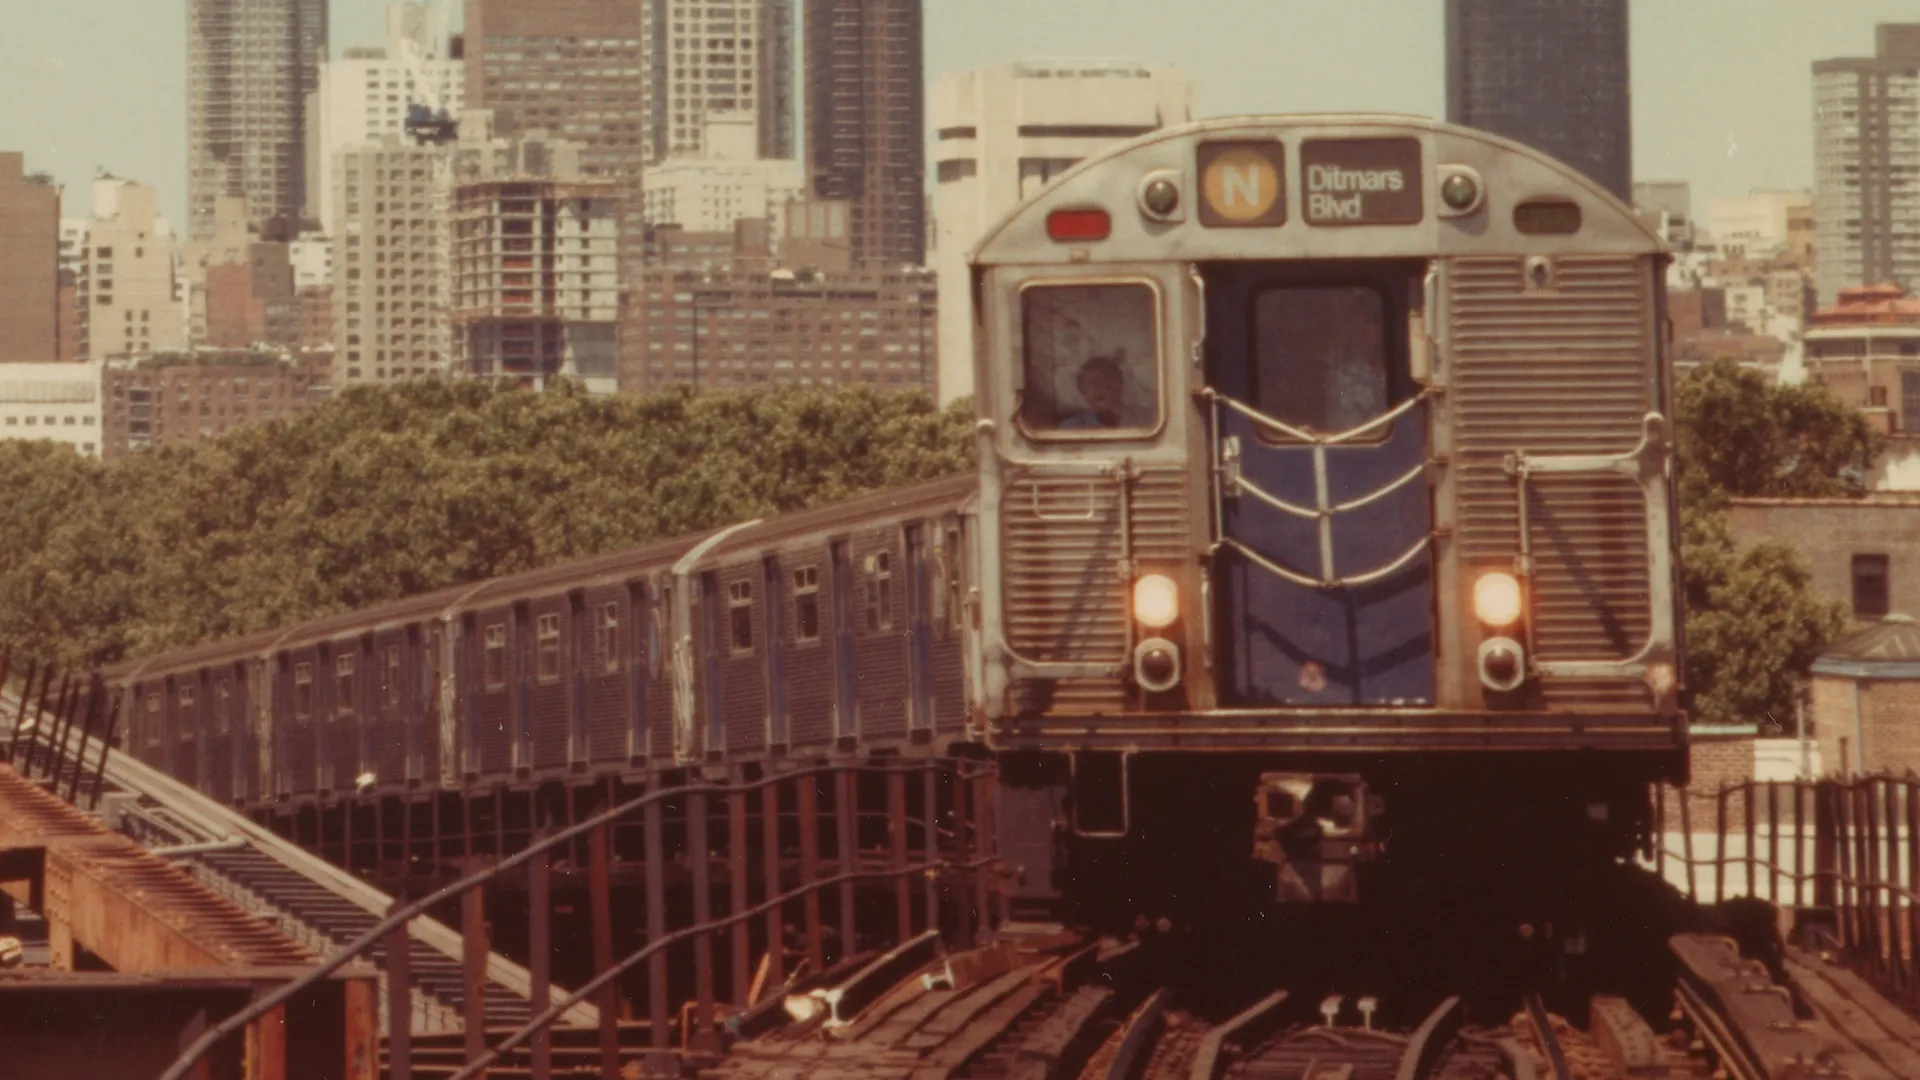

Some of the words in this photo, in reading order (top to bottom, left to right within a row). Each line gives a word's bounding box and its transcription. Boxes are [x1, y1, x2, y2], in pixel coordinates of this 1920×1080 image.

[1222, 164, 1260, 207] N
[1307, 165, 1404, 191] Ditmars
[1308, 193, 1363, 219] Blvd
